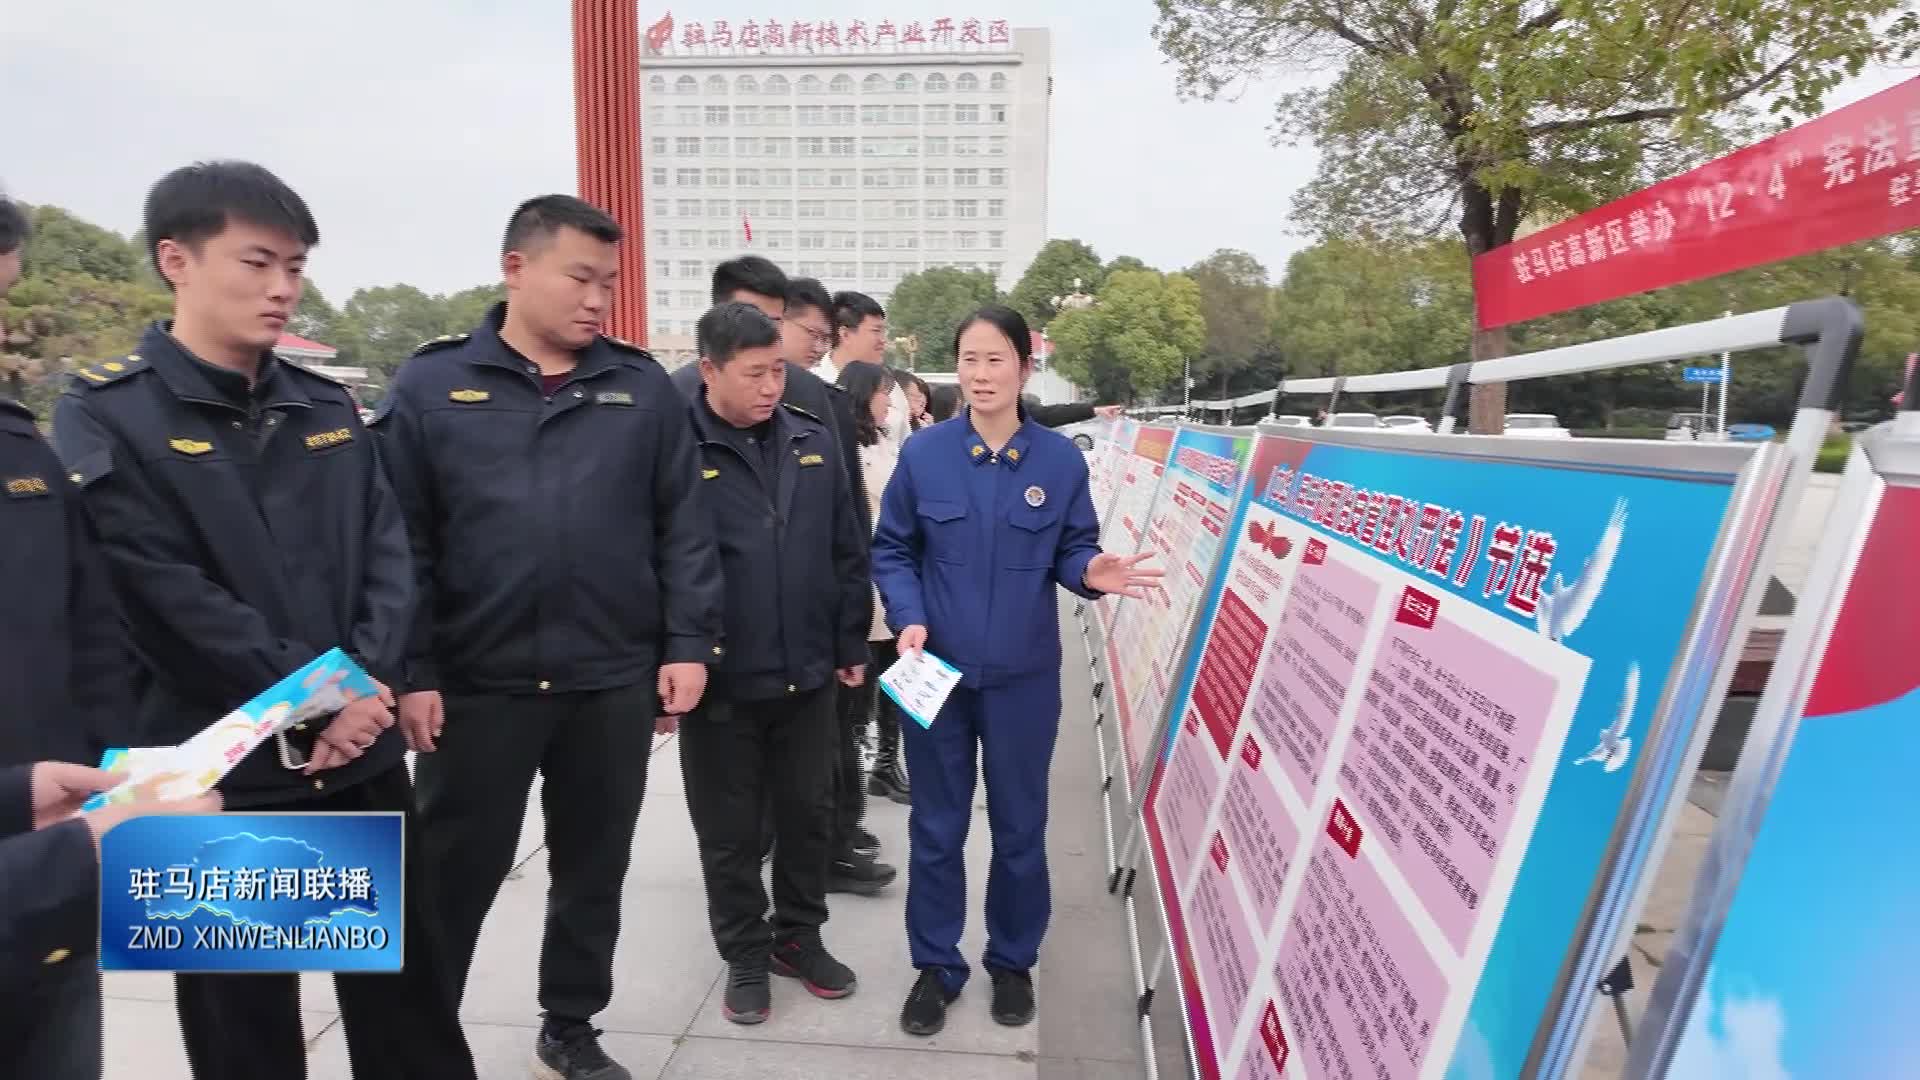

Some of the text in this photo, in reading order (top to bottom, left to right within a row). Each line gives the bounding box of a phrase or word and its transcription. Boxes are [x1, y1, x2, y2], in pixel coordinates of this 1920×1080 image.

[680, 17, 1008, 47] 驻马店高新技术产业开发区
